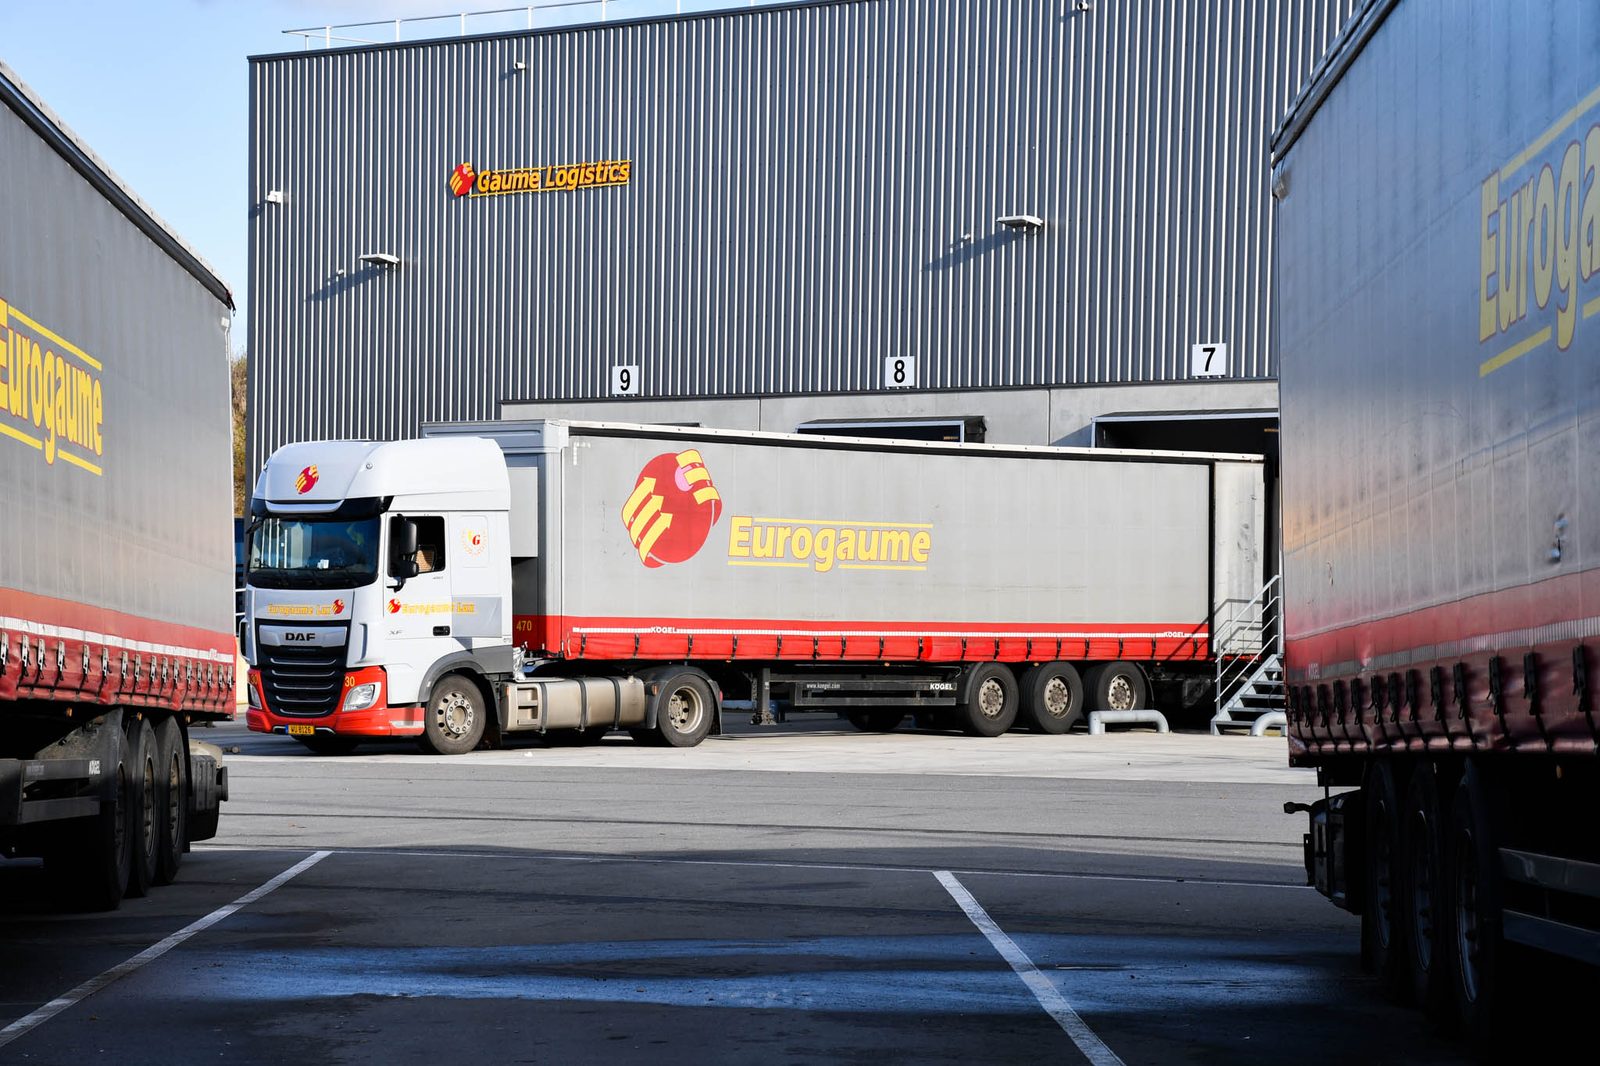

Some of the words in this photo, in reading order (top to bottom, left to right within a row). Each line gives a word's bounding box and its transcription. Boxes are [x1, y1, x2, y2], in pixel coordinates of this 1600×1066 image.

[477, 169, 541, 193] Gaume
[545, 160, 631, 191] Logistics
[893, 359, 906, 384] 8
[1202, 347, 1216, 372] 7
[620, 368, 631, 392] 9
[728, 515, 931, 572] Eurogaume
[285, 632, 316, 642] DAF
[516, 620, 532, 631] 470
[344, 676, 356, 688] 30
